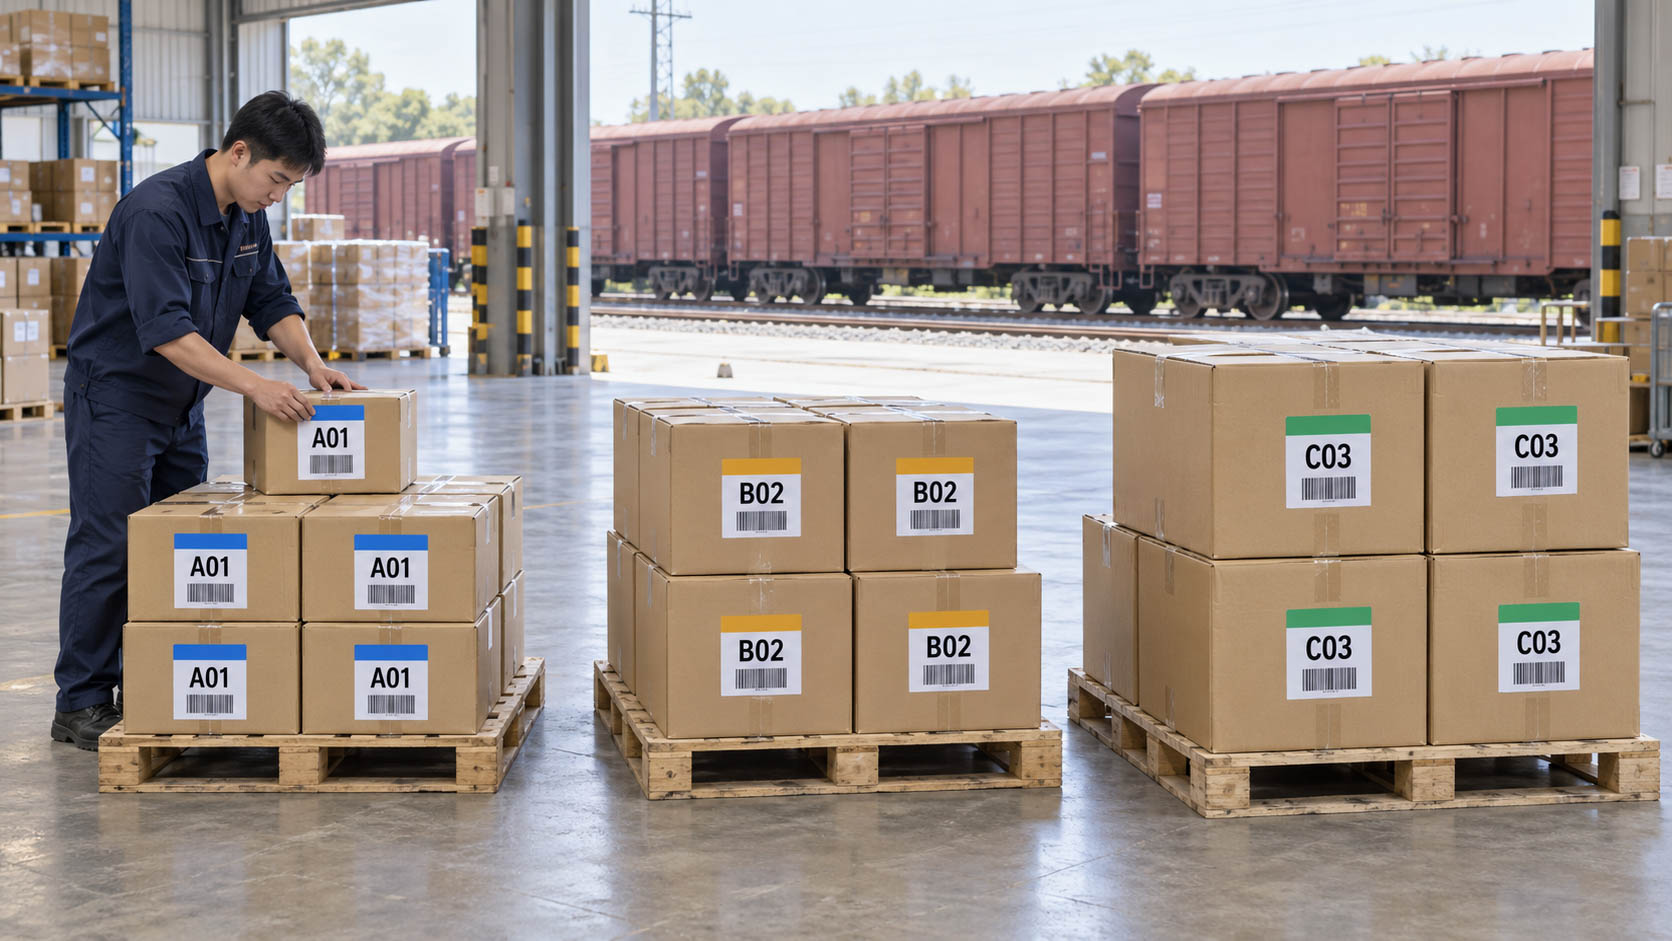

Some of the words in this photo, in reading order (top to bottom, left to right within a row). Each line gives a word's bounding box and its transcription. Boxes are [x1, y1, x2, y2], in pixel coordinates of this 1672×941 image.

[311, 426, 348, 449] A01
[1514, 433, 1559, 459] C03
[1305, 443, 1352, 470] C03
[740, 481, 784, 505] B02
[913, 480, 957, 504] B02
[189, 555, 229, 578] A01
[370, 556, 409, 579] A01
[739, 638, 784, 663] B02
[926, 634, 972, 659] B02
[1305, 634, 1352, 661] C03
[1516, 629, 1561, 655] C03
[189, 666, 228, 689] A01
[370, 666, 409, 689] A01
